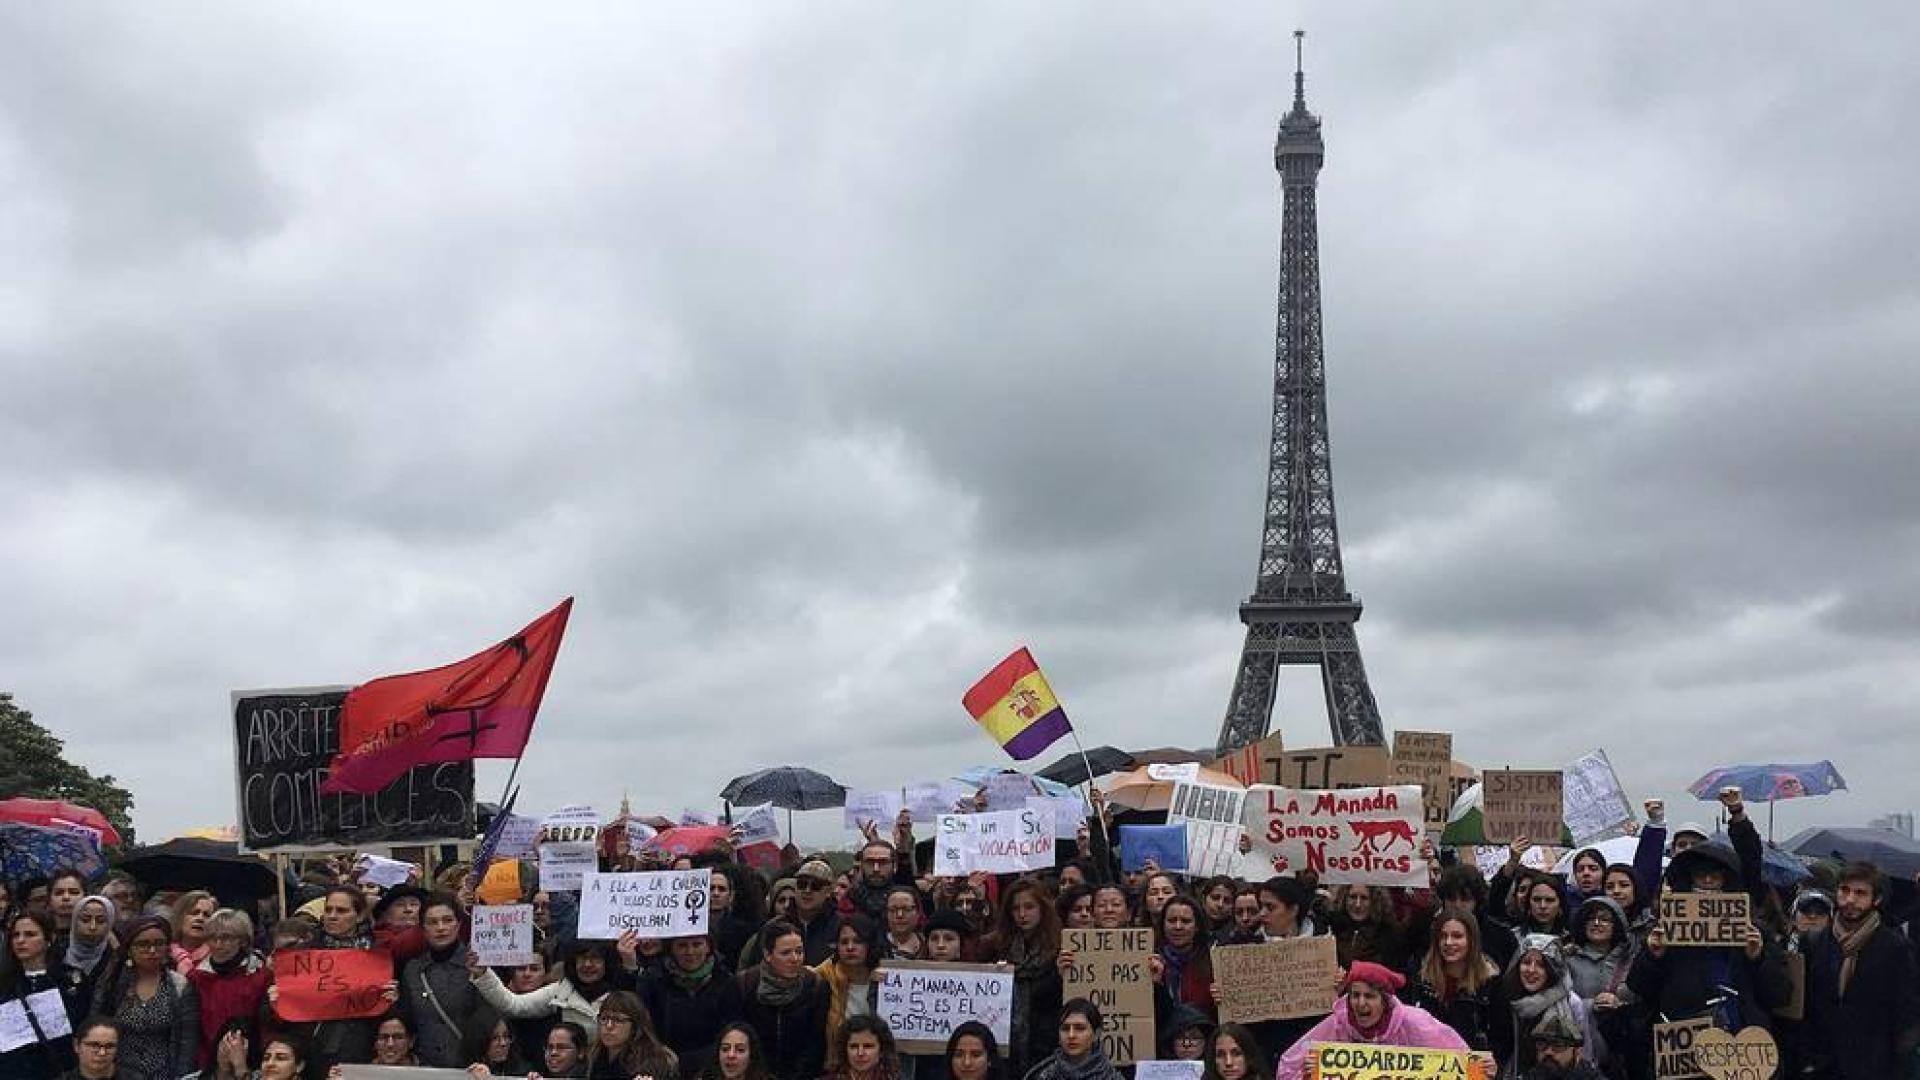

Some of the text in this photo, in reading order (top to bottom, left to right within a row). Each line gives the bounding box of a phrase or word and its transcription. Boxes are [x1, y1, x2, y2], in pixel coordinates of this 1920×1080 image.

[247, 702, 342, 764] ARRÊTE
[1493, 774, 1557, 794] SISTER
[981, 822, 998, 834] un
[1305, 840, 1411, 874] Nosotras
[1662, 899, 1746, 918] JE SUIS
[1070, 930, 1148, 953] SI JE NE
[1664, 919, 1746, 942] VIOLÉE
[294, 952, 334, 977] NO
[1068, 962, 1141, 984] DIS PAS
[884, 970, 903, 988] LA
[975, 979, 1001, 997] NO
[934, 998, 951, 1013] ES
[959, 998, 977, 1015] EL
[1101, 1034, 1134, 1062] ON
[1694, 1042, 1775, 1067] RESPECTE
[1321, 1049, 1425, 1072] COBARDE
[1659, 1050, 1703, 1077] AUSS
